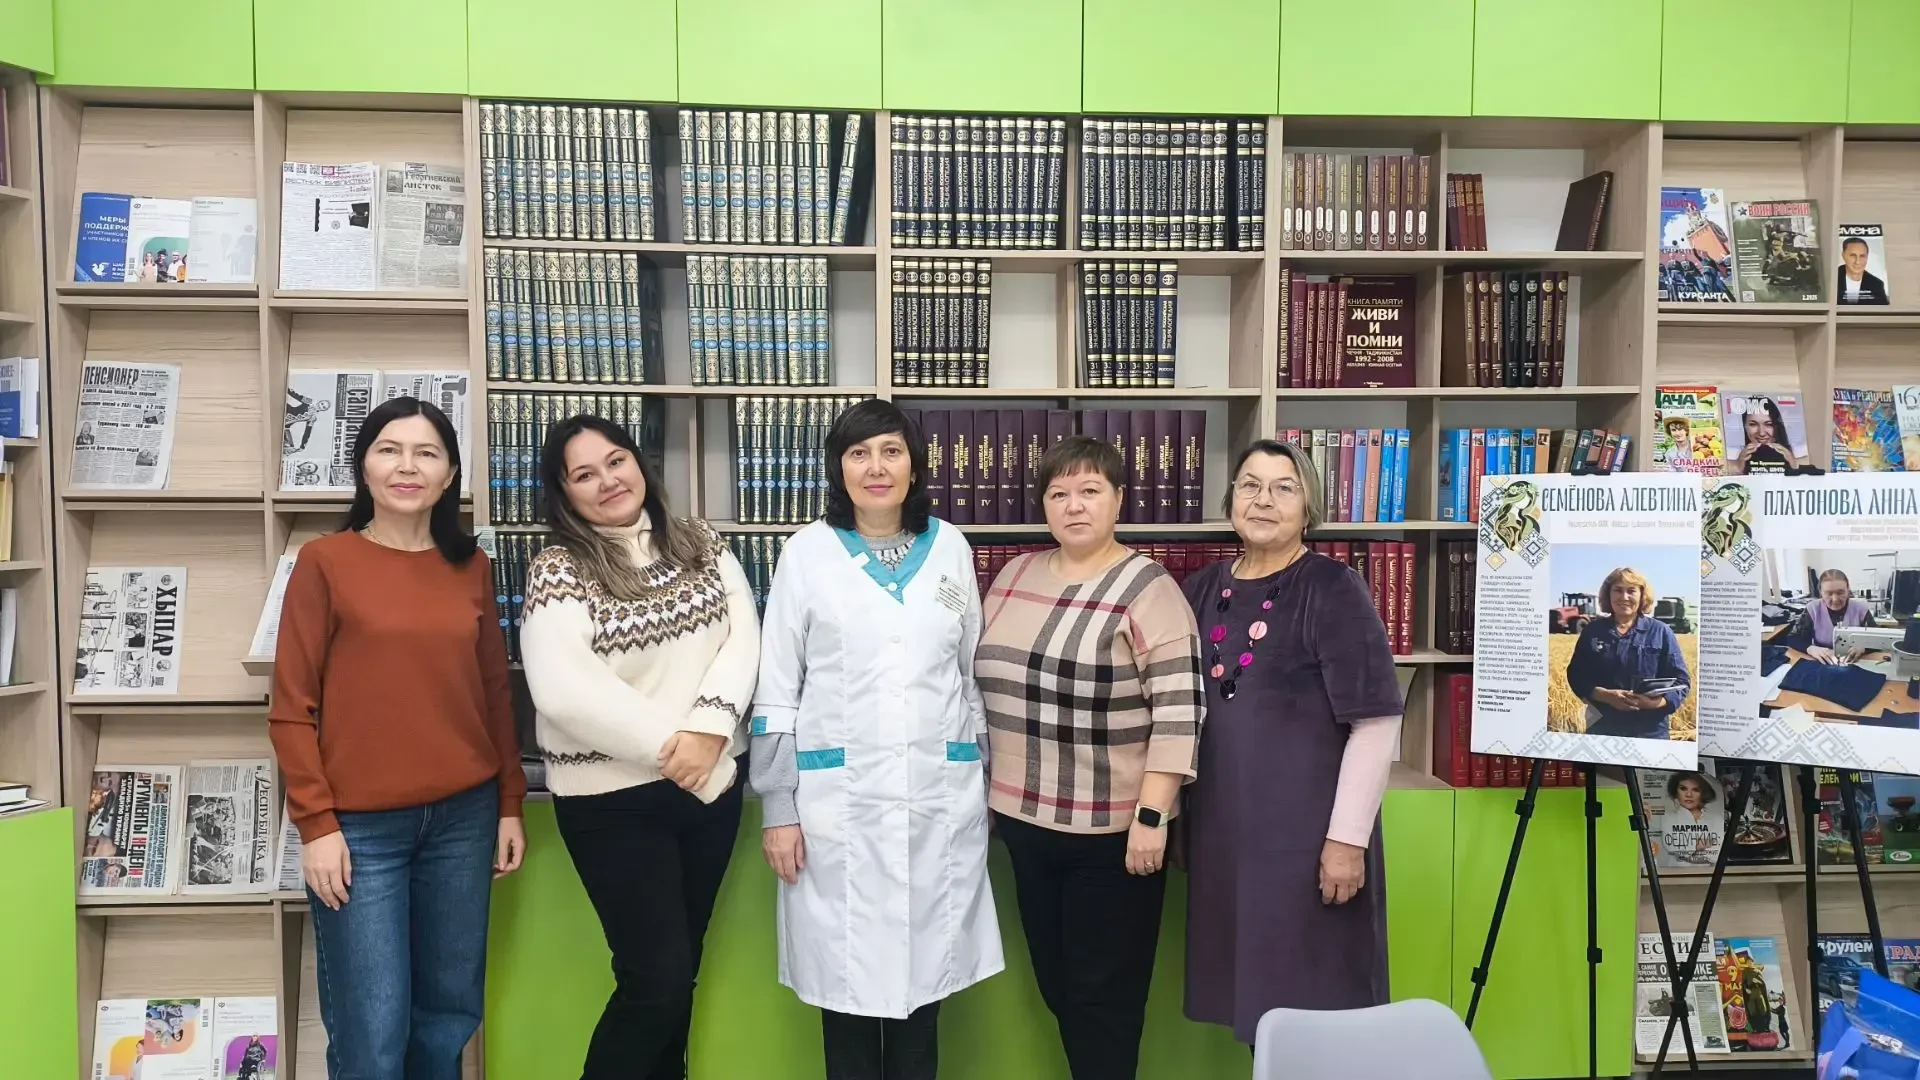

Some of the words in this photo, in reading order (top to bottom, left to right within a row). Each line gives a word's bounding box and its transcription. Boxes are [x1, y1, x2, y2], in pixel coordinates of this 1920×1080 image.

[1748, 204, 1772, 217] ВОИН
[1773, 203, 1810, 216] РОССИИ
[84, 223, 128, 231] ПОДДЕРЖ
[1172, 224, 1181, 232] 18
[1187, 223, 1195, 231] 19
[1215, 223, 1224, 231] 21
[1240, 224, 1249, 232] 22
[1280, 269, 1289, 288] РАЙОНА
[1678, 292, 1728, 300] КУРСАНТА
[1280, 288, 1288, 328] ЧЕБОКСАРСКОГО
[1351, 308, 1399, 320] ЖИВИ
[1369, 322, 1380, 334] И
[1280, 330, 1288, 368] ЭНЦИКЛОПЕДИЯ
[1347, 335, 1403, 347] ПОМНИ
[84, 366, 140, 386] ПЕНСИОНЕР
[1186, 499, 1199, 507] XII
[1541, 485, 1615, 512] СЕМЁНОВА
[1620, 487, 1697, 512] АЛЕВТИНА
[1764, 489, 1862, 516] ПЛАТОНОВА
[1868, 488, 1918, 515] АННА
[152, 586, 178, 656] ХЫПАР
[118, 778, 127, 815] ЗАПАДНУЮ
[133, 772, 152, 834] АРГУМЕНТЫ
[158, 805, 168, 836] АВИАПРОМ
[1672, 824, 1708, 832] МАРИНА
[114, 815, 123, 846] УКРАИНУ
[121, 812, 130, 849] КОШМАРЯТ
[156, 836, 165, 859] УХОДИТ
[1664, 833, 1721, 849] ФЕДУНКИВ:
[128, 837, 147, 876] НЕДЕЛИ
[1727, 965, 1738, 982] 9
